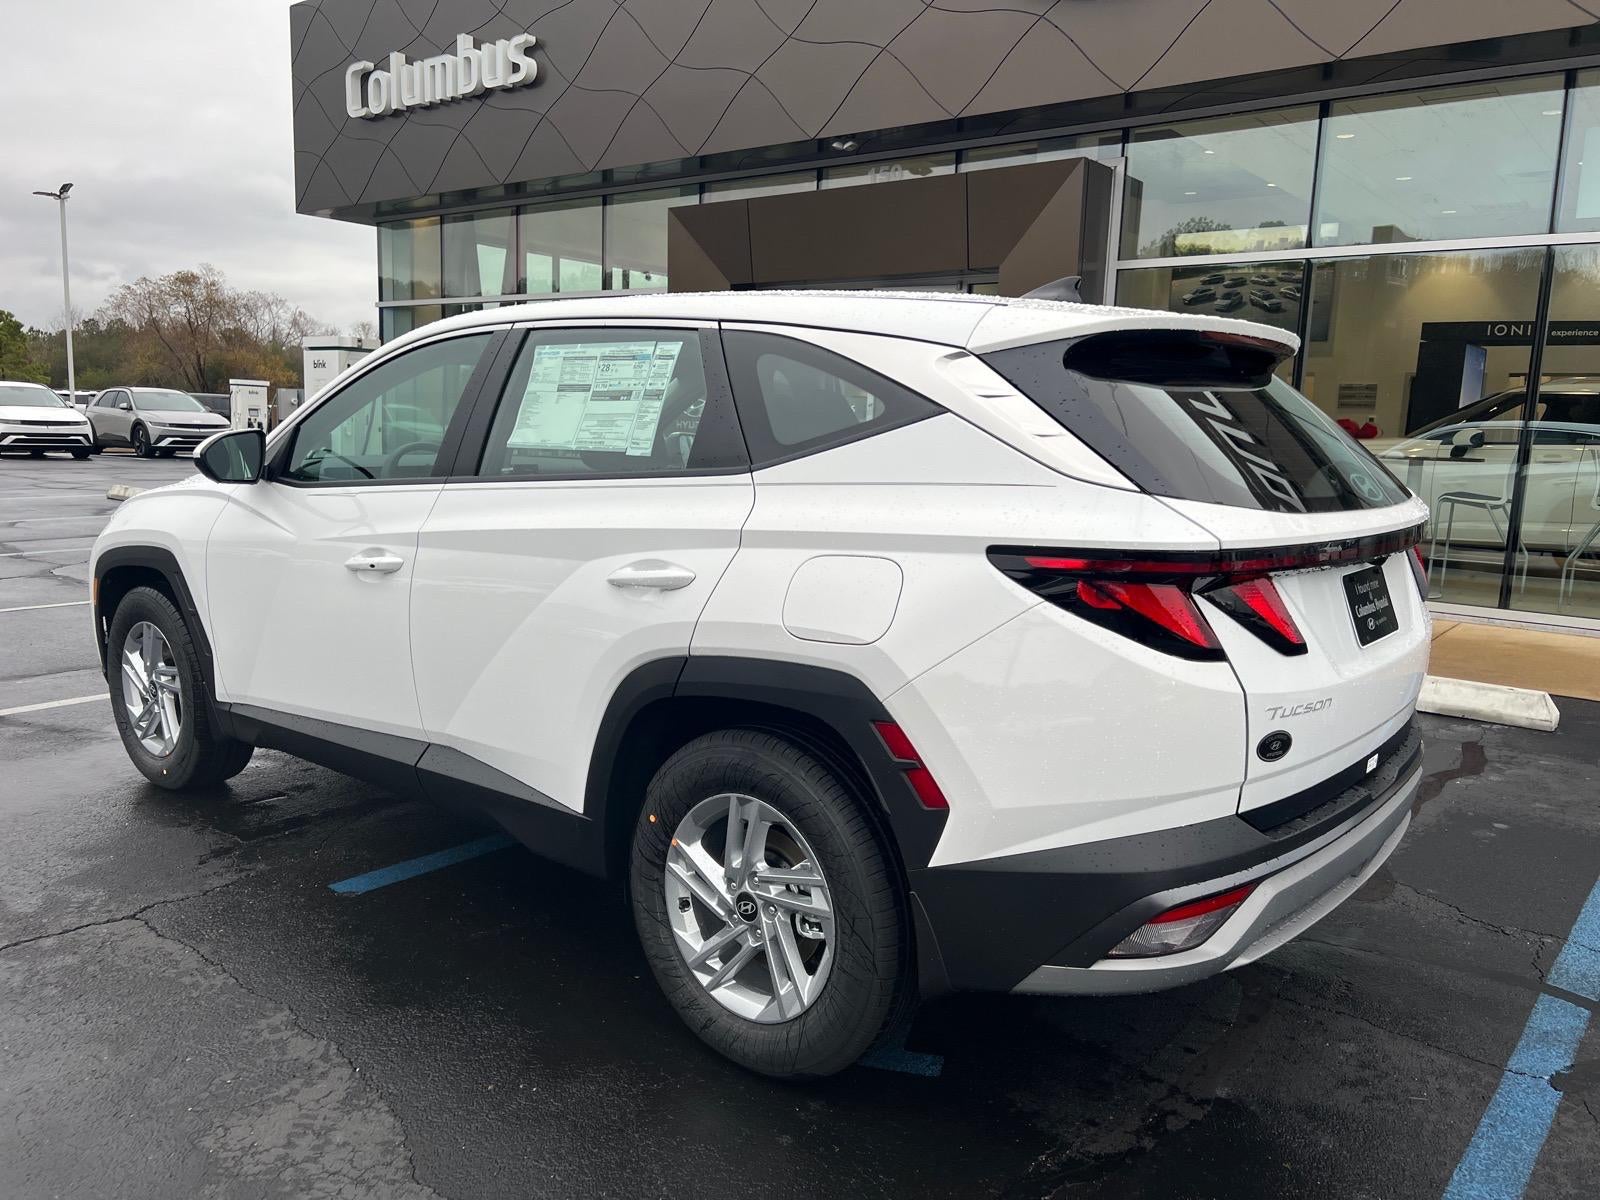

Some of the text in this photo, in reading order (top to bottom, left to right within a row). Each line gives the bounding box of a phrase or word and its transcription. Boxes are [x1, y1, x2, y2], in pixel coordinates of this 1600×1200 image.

[345, 33, 538, 118] Columbus
[1487, 323, 1599, 337] IONI experience
[313, 360, 327, 369] blink
